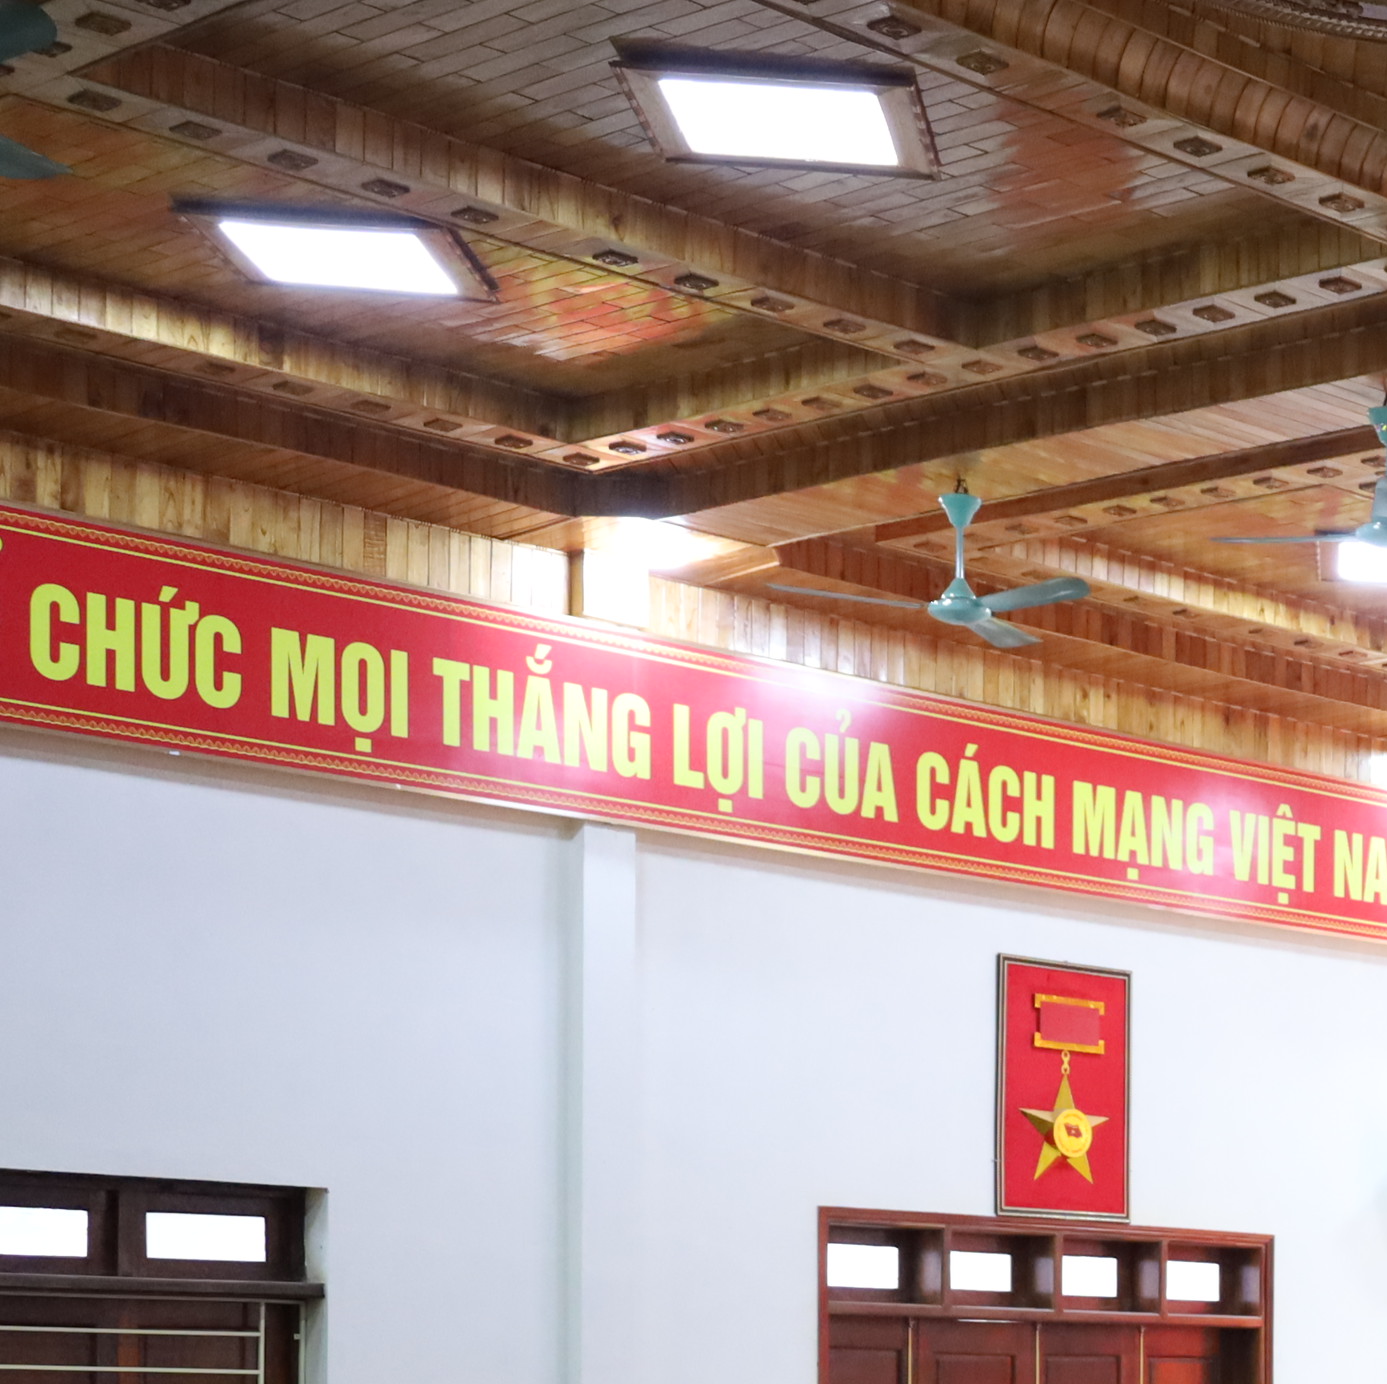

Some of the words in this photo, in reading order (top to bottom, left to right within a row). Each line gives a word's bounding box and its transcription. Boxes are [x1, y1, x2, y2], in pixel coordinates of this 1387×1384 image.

[29, 584, 243, 709] CHỨC
[270, 627, 409, 753] MỌI
[433, 643, 652, 780] THẮNG
[672, 703, 764, 812] LỢI
[784, 708, 899, 823] CỦA
[915, 743, 1056, 849] CÁCH
[1072, 779, 1214, 880] MẠNG
[1229, 803, 1322, 905] VIỆT
